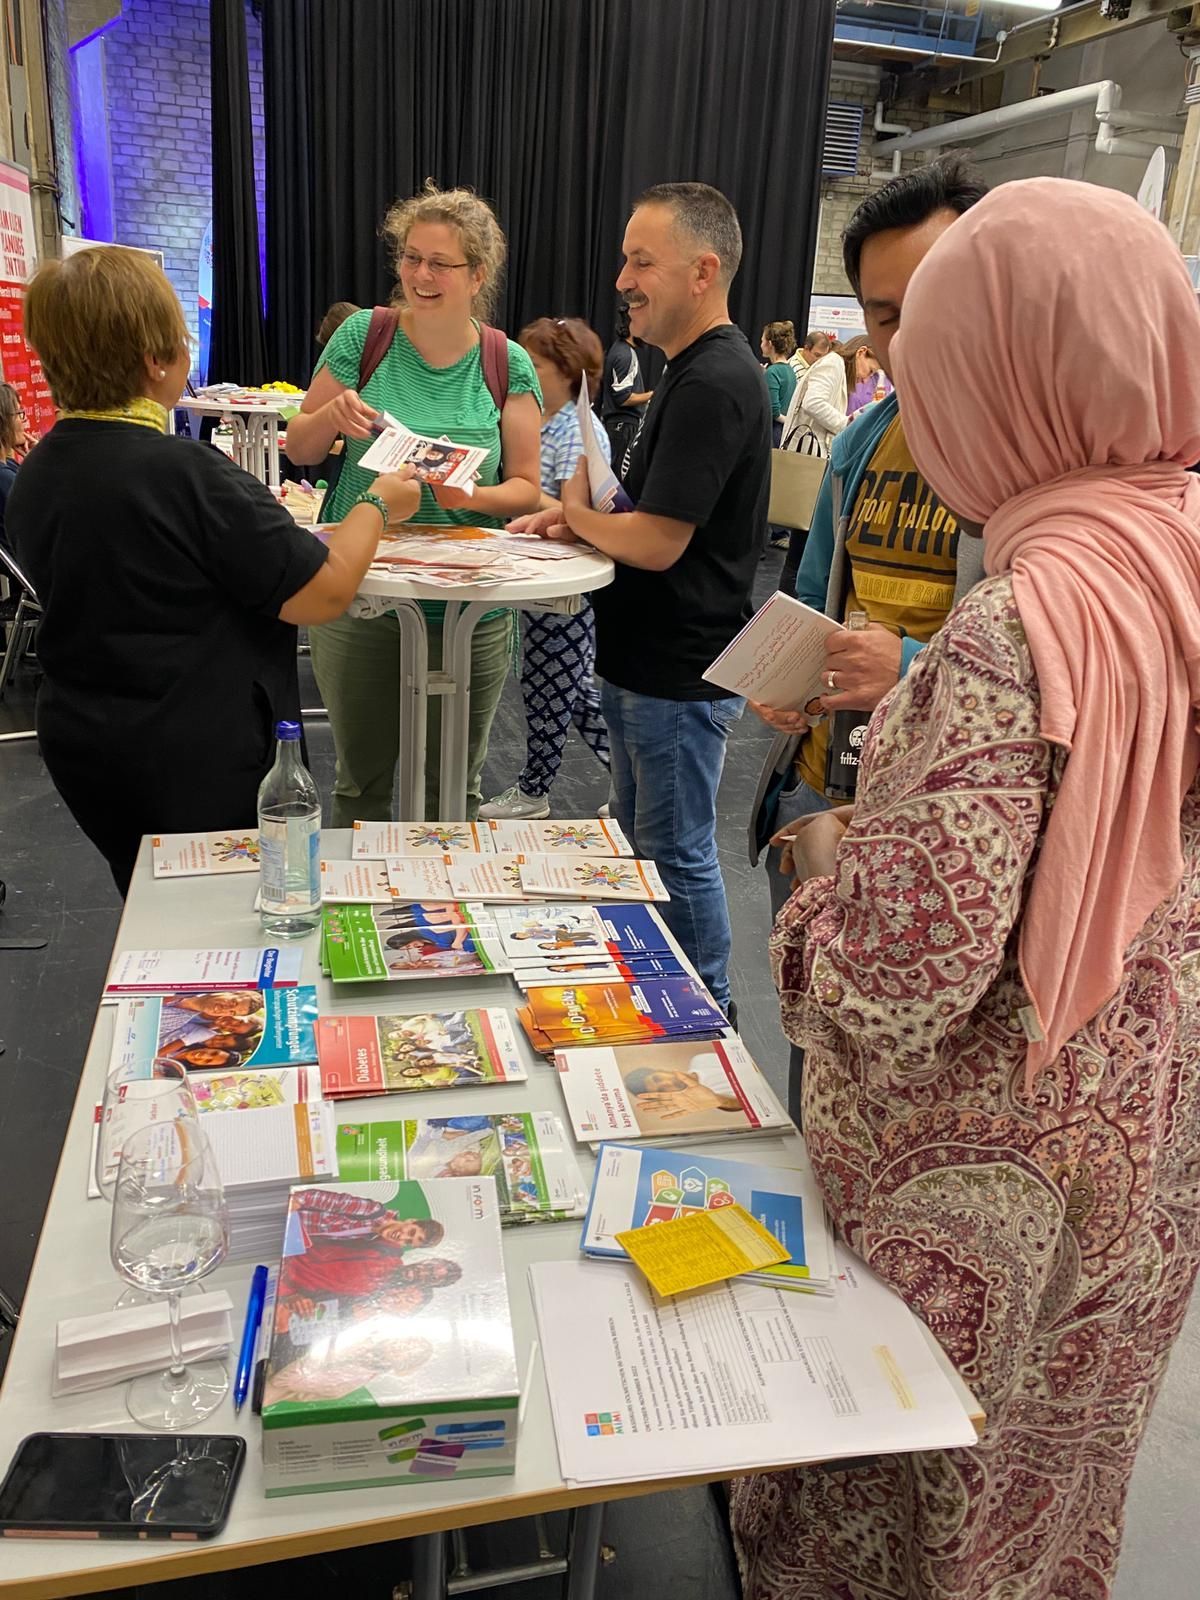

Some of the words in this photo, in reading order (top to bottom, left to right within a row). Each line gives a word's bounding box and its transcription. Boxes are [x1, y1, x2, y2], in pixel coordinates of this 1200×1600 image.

[857, 498, 892, 525] TOM
[840, 751, 861, 766] fritz-
[263, 957, 275, 978] Begleiter
[561, 988, 587, 1024] DEMENZ
[284, 989, 302, 1054] Schutzimpfungen
[357, 1047, 369, 1084] Diabetes
[612, 1087, 627, 1109] koruma
[377, 1137, 390, 1181] gesundheit
[473, 1195, 484, 1220] fom
